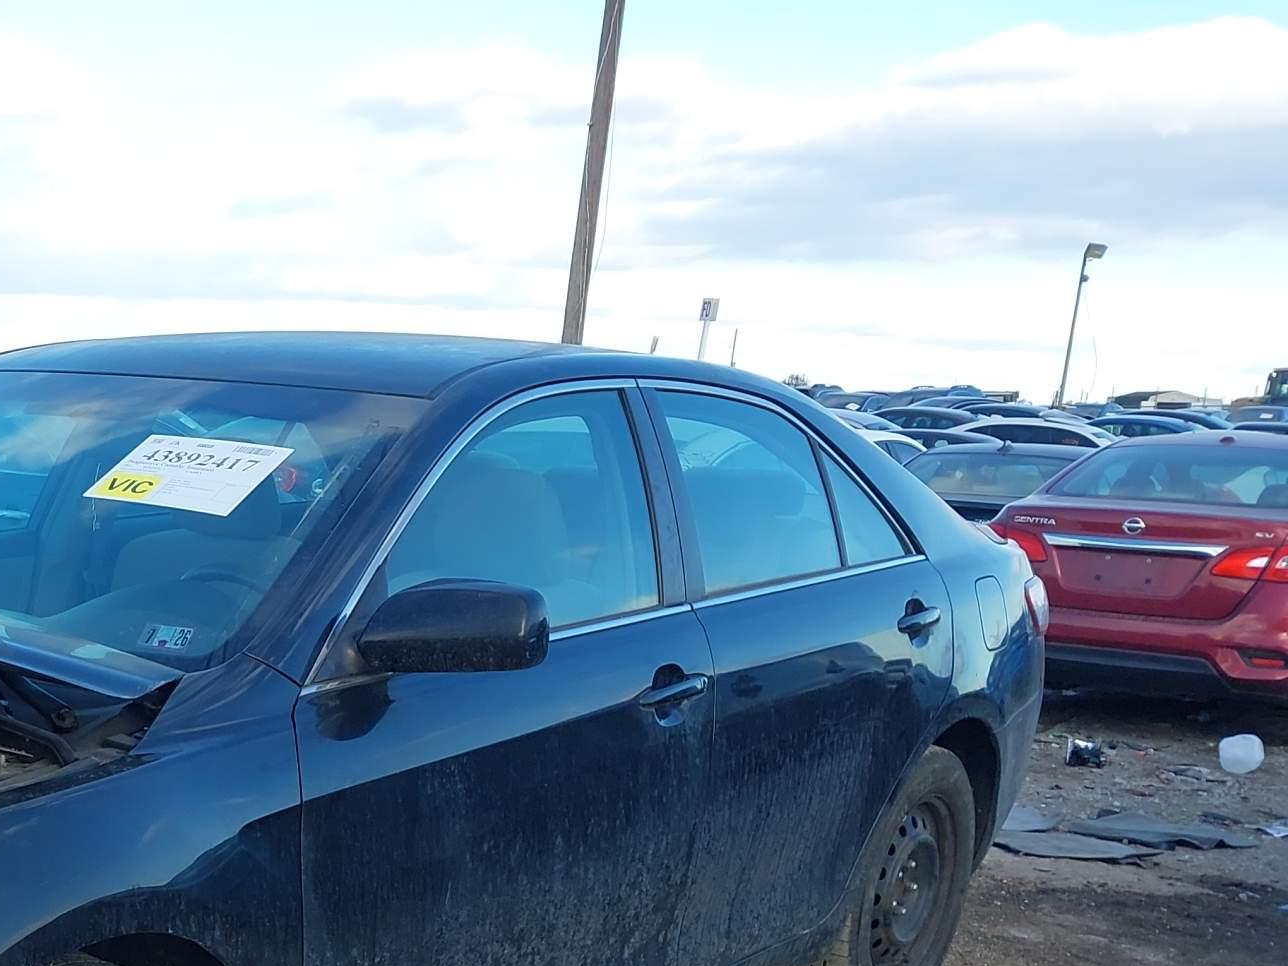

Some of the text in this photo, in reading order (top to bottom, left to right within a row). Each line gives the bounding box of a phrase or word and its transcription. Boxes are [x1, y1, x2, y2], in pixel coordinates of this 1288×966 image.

[143, 448, 261, 472] 43892417
[108, 477, 154, 494] VIC
[1014, 515, 1056, 526] SENTRA
[174, 629, 192, 647] 26
